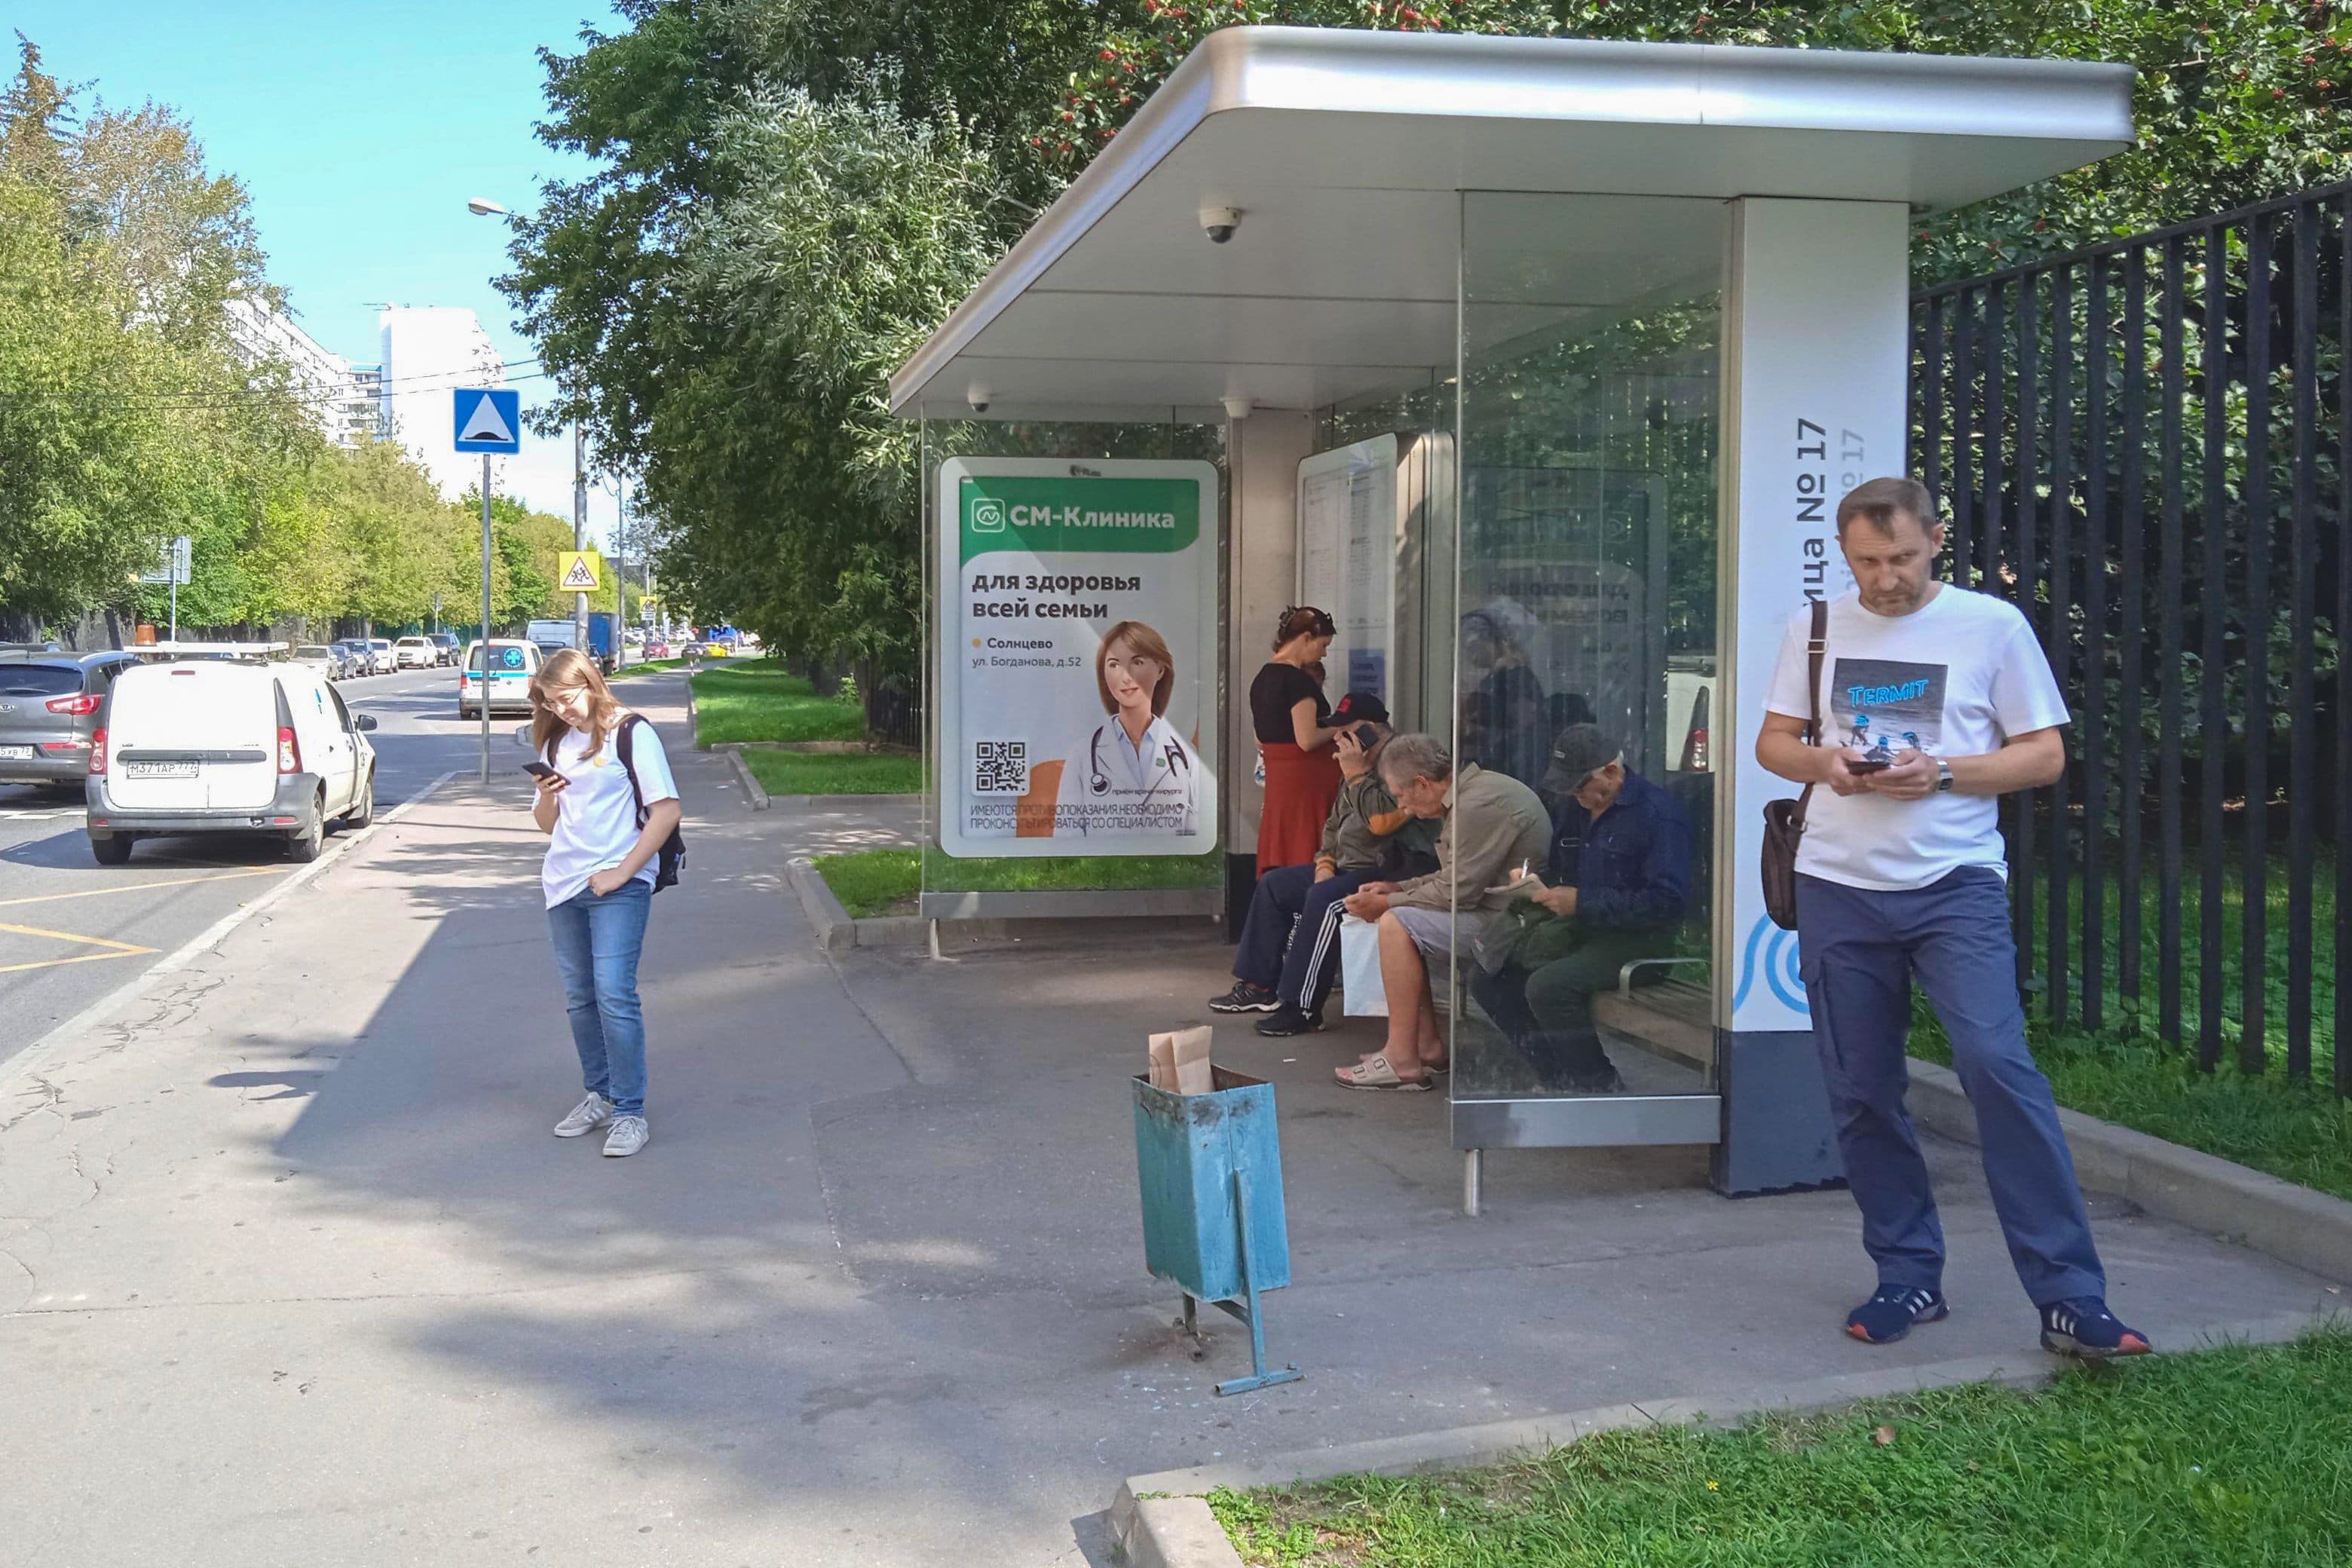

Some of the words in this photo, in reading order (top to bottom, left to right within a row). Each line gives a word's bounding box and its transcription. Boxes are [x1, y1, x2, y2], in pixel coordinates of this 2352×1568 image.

[1797, 418, 1826, 461] 17
[1010, 505, 1175, 528] СМ-Клиника
[972, 575, 1020, 593] для
[1025, 575, 1141, 596] здоровья
[973, 598, 1029, 617] всей
[1035, 603, 1108, 617] семьи
[988, 638, 1053, 650] Солнцево
[972, 659, 988, 668] ул.
[991, 657, 1054, 667] Богданова,
[1848, 679, 1928, 707] TERMIT
[971, 804, 1016, 815] ИМЕЮТСЯ
